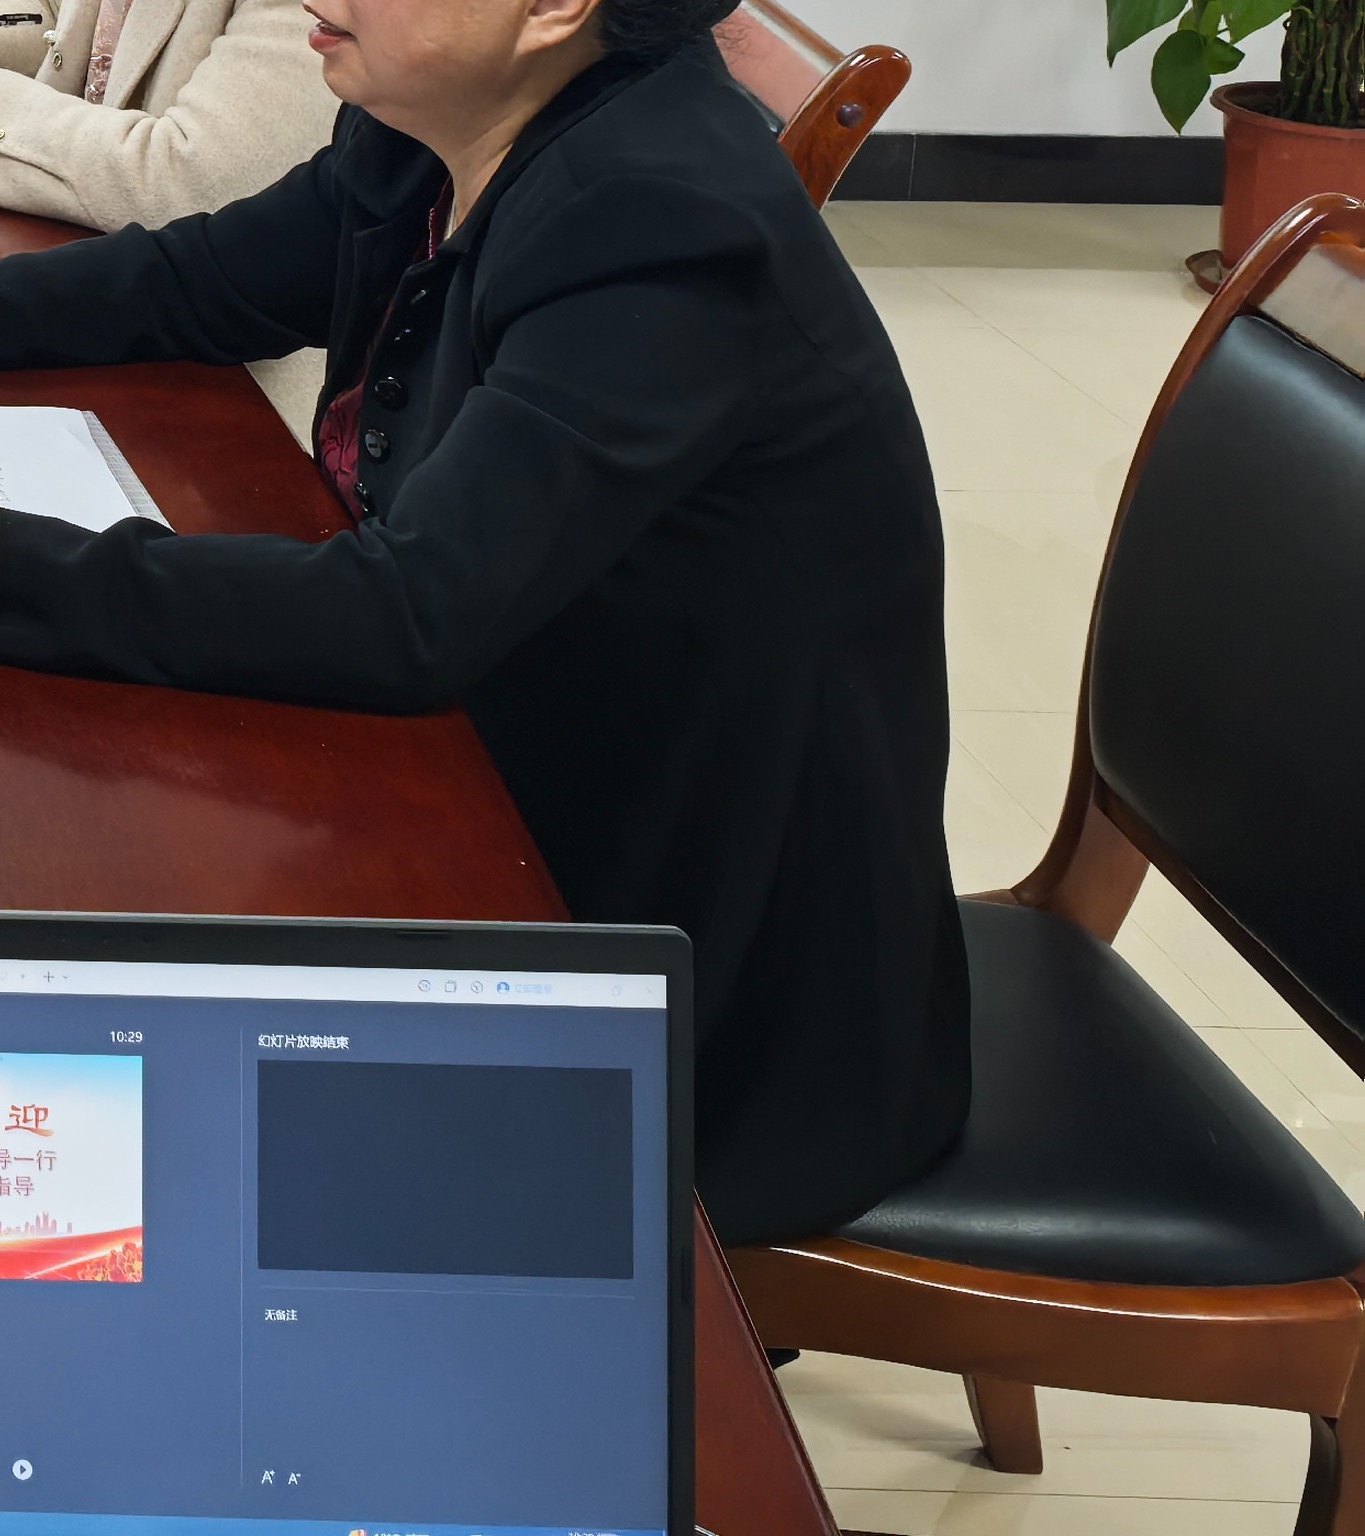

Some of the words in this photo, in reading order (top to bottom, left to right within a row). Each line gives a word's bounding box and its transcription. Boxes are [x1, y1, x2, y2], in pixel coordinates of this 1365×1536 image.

[109, 1029, 144, 1044] 10:29
[258, 1033, 350, 1051] 幻灯片放映结束
[264, 1309, 299, 1323] 无备注
